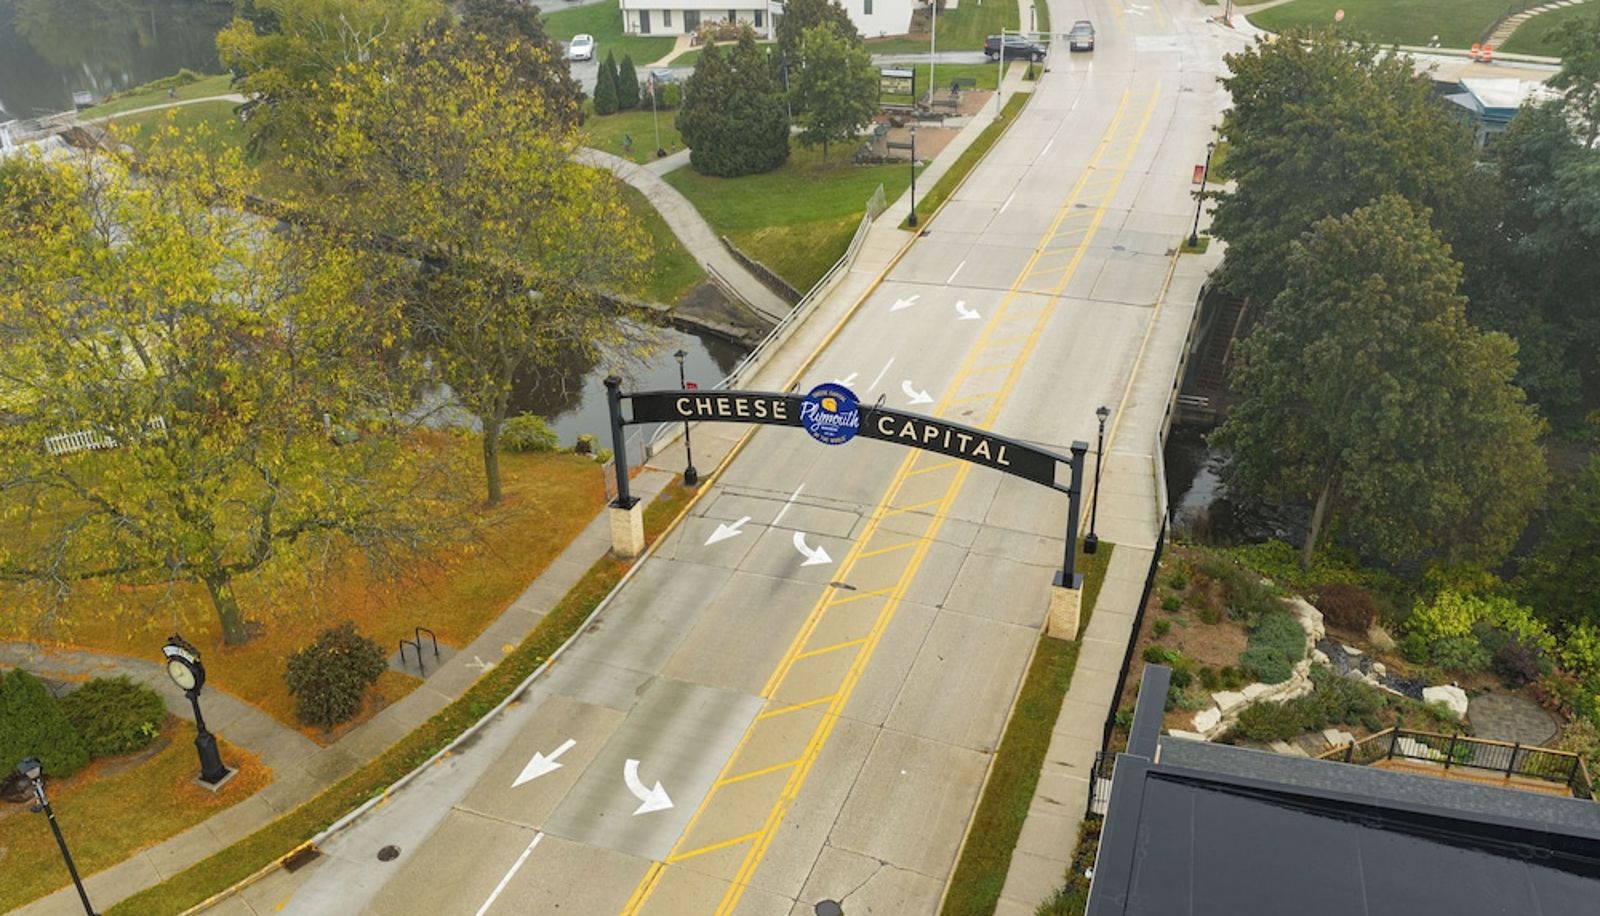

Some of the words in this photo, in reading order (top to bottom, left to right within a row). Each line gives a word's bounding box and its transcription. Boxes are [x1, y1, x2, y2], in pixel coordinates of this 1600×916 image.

[676, 397, 787, 419] CHEESE
[878, 416, 1010, 466] CAPITAL
[800, 401, 860, 431] Plymouth
